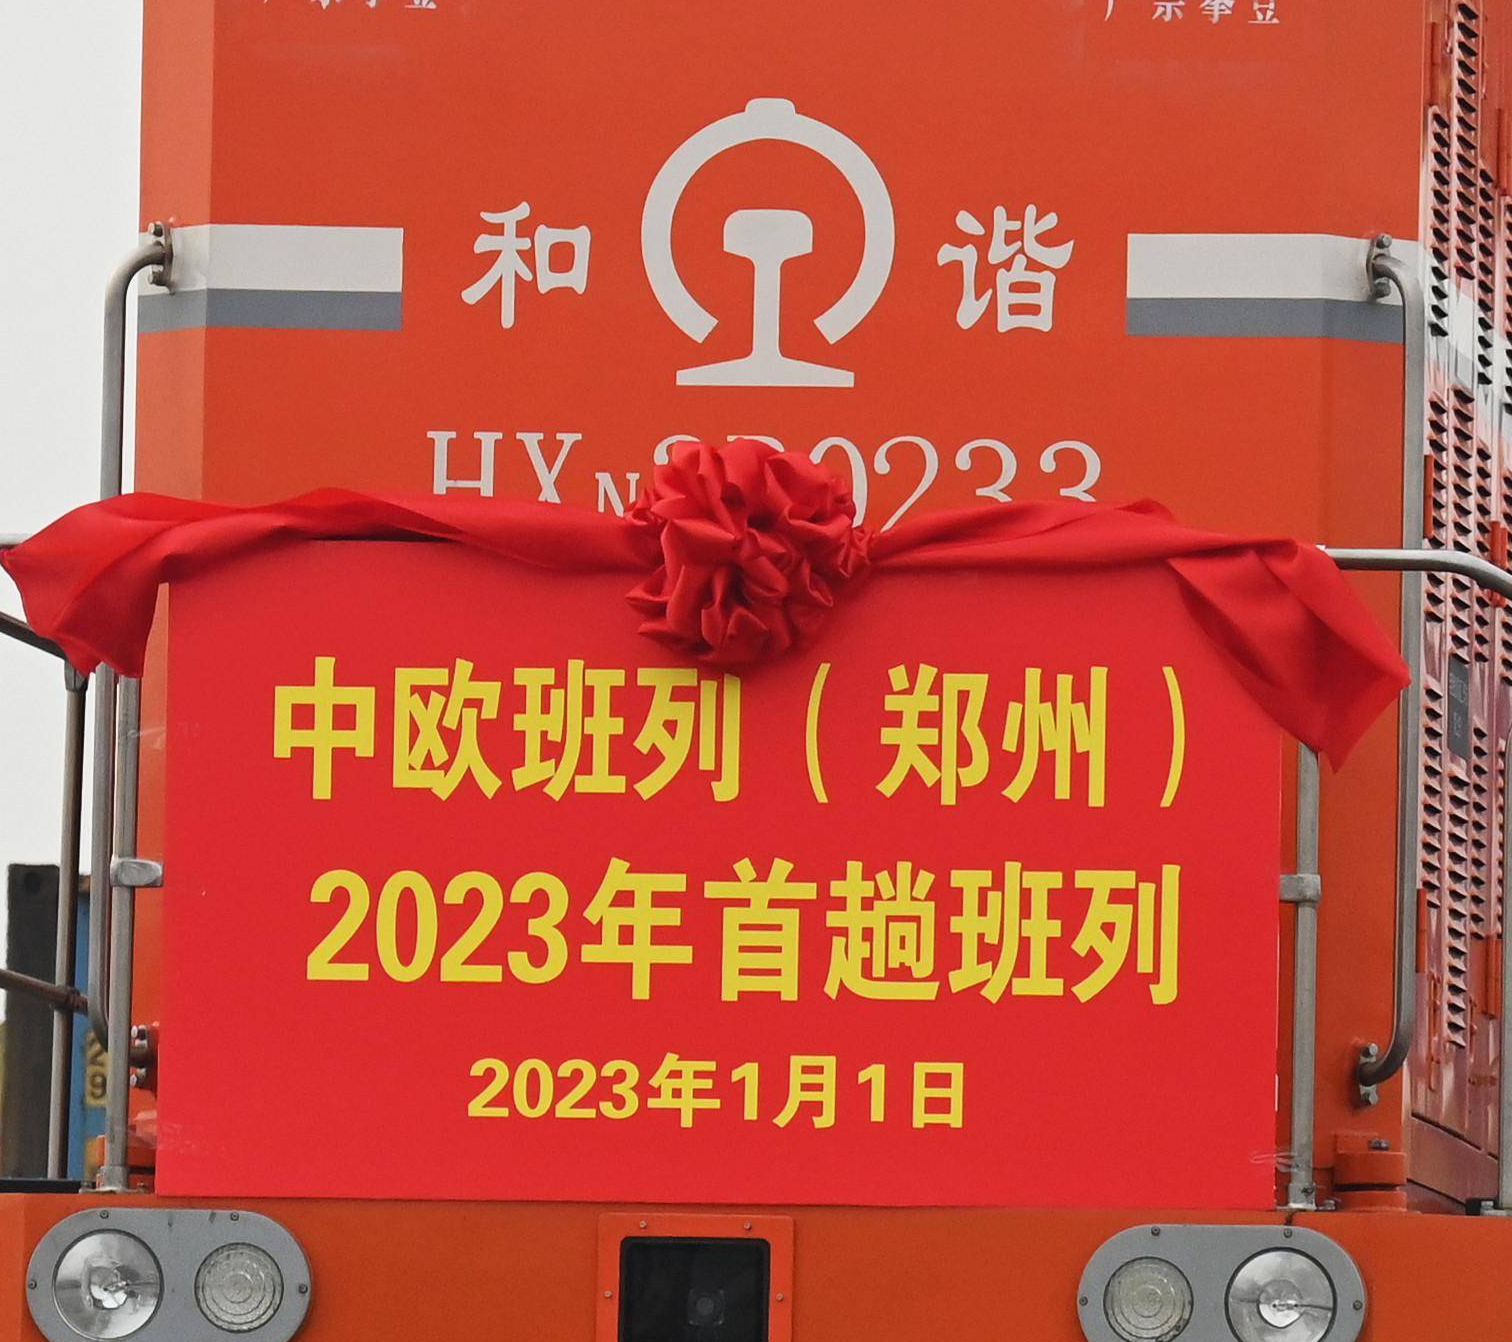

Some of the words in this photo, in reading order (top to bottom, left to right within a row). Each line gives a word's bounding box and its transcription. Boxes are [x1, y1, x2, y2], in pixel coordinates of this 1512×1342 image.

[461, 200, 591, 330] 和
[937, 203, 1076, 333] 谐
[272, 656, 1188, 809] 中欧班列（郑州）
[306, 858, 1182, 1007] 2023年首趟班列
[467, 1052, 968, 1130] 2023年1月1日
